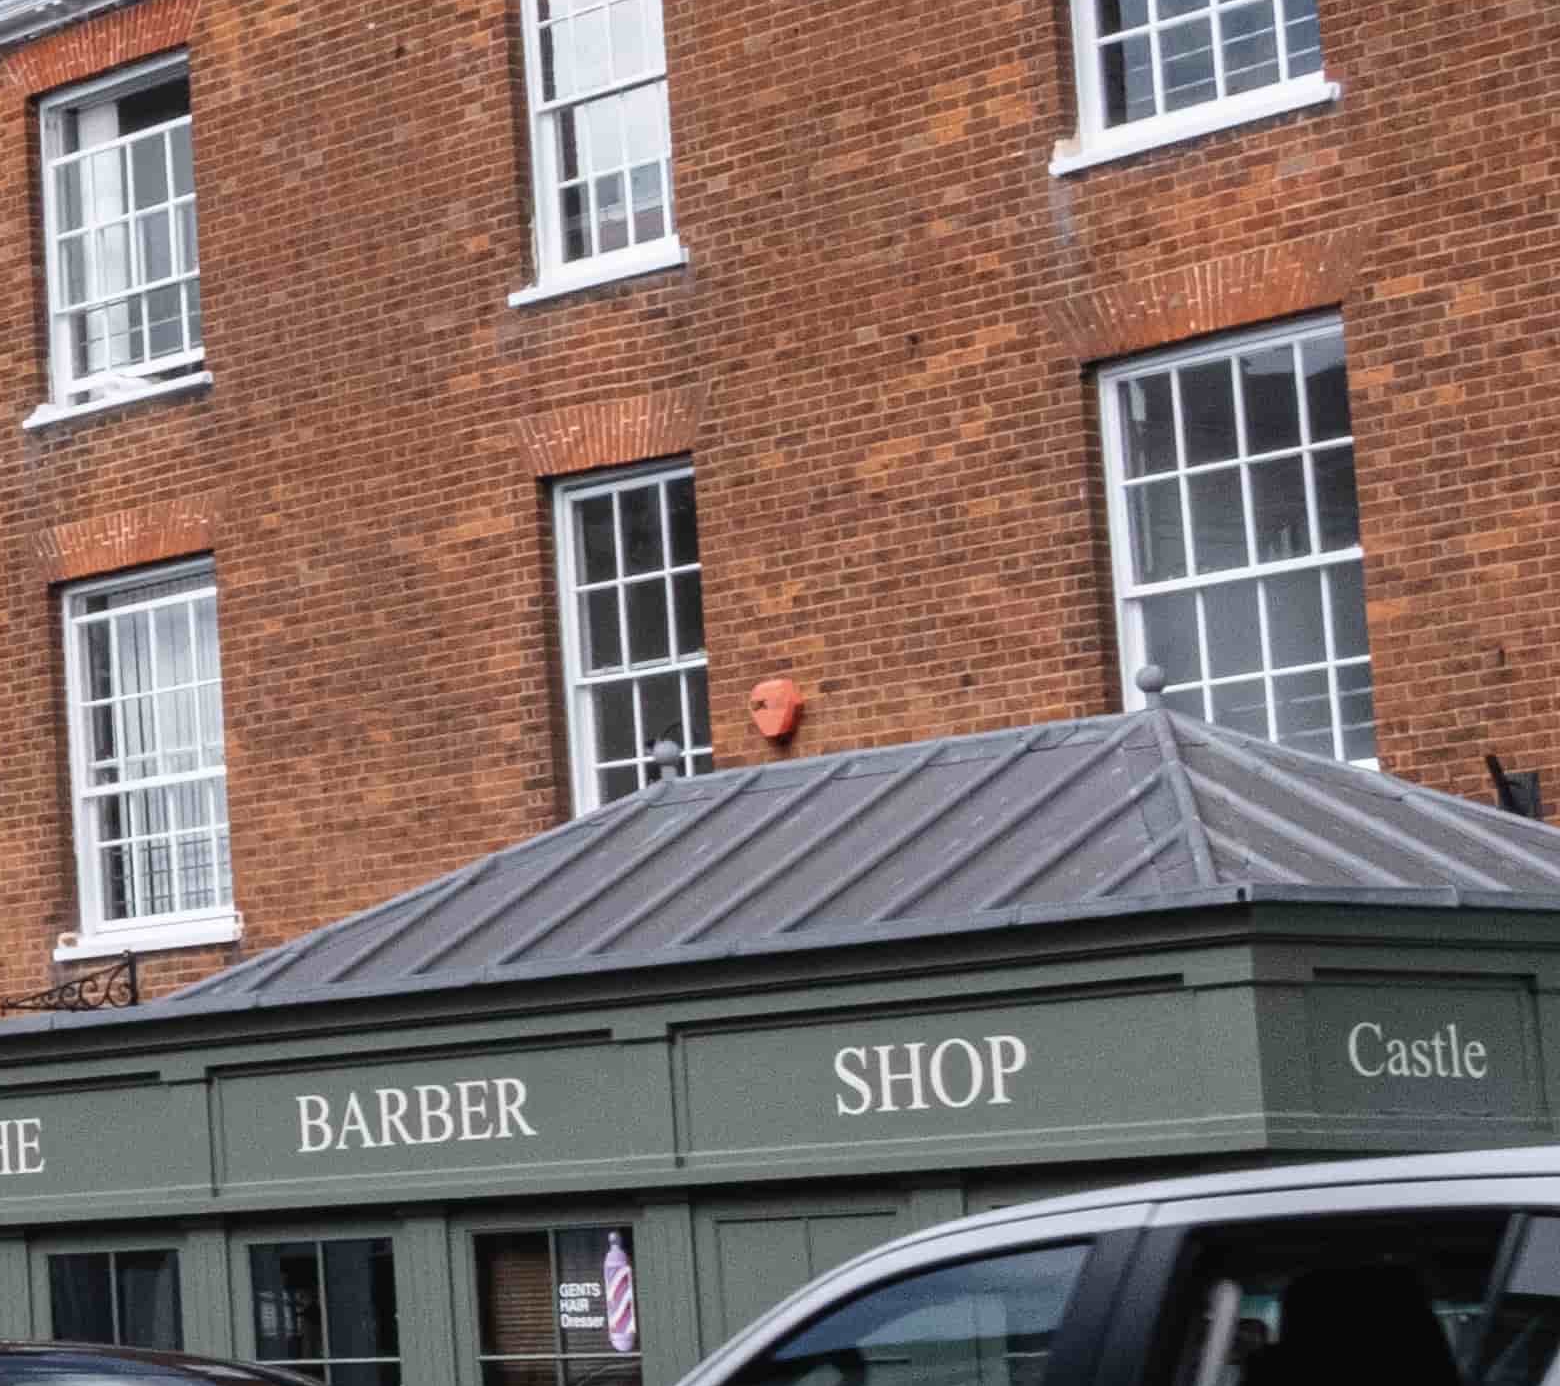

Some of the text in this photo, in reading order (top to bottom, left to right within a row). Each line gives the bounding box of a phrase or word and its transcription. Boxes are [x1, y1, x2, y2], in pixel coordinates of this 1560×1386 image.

[1347, 1021, 1489, 1080] Castle
[296, 1077, 537, 1153] BARBER
[833, 1033, 1028, 1116] SHOP
[559, 1282, 601, 1298] GENTS
[559, 1298, 589, 1313] HAIR
[560, 1313, 606, 1329] Dresser
